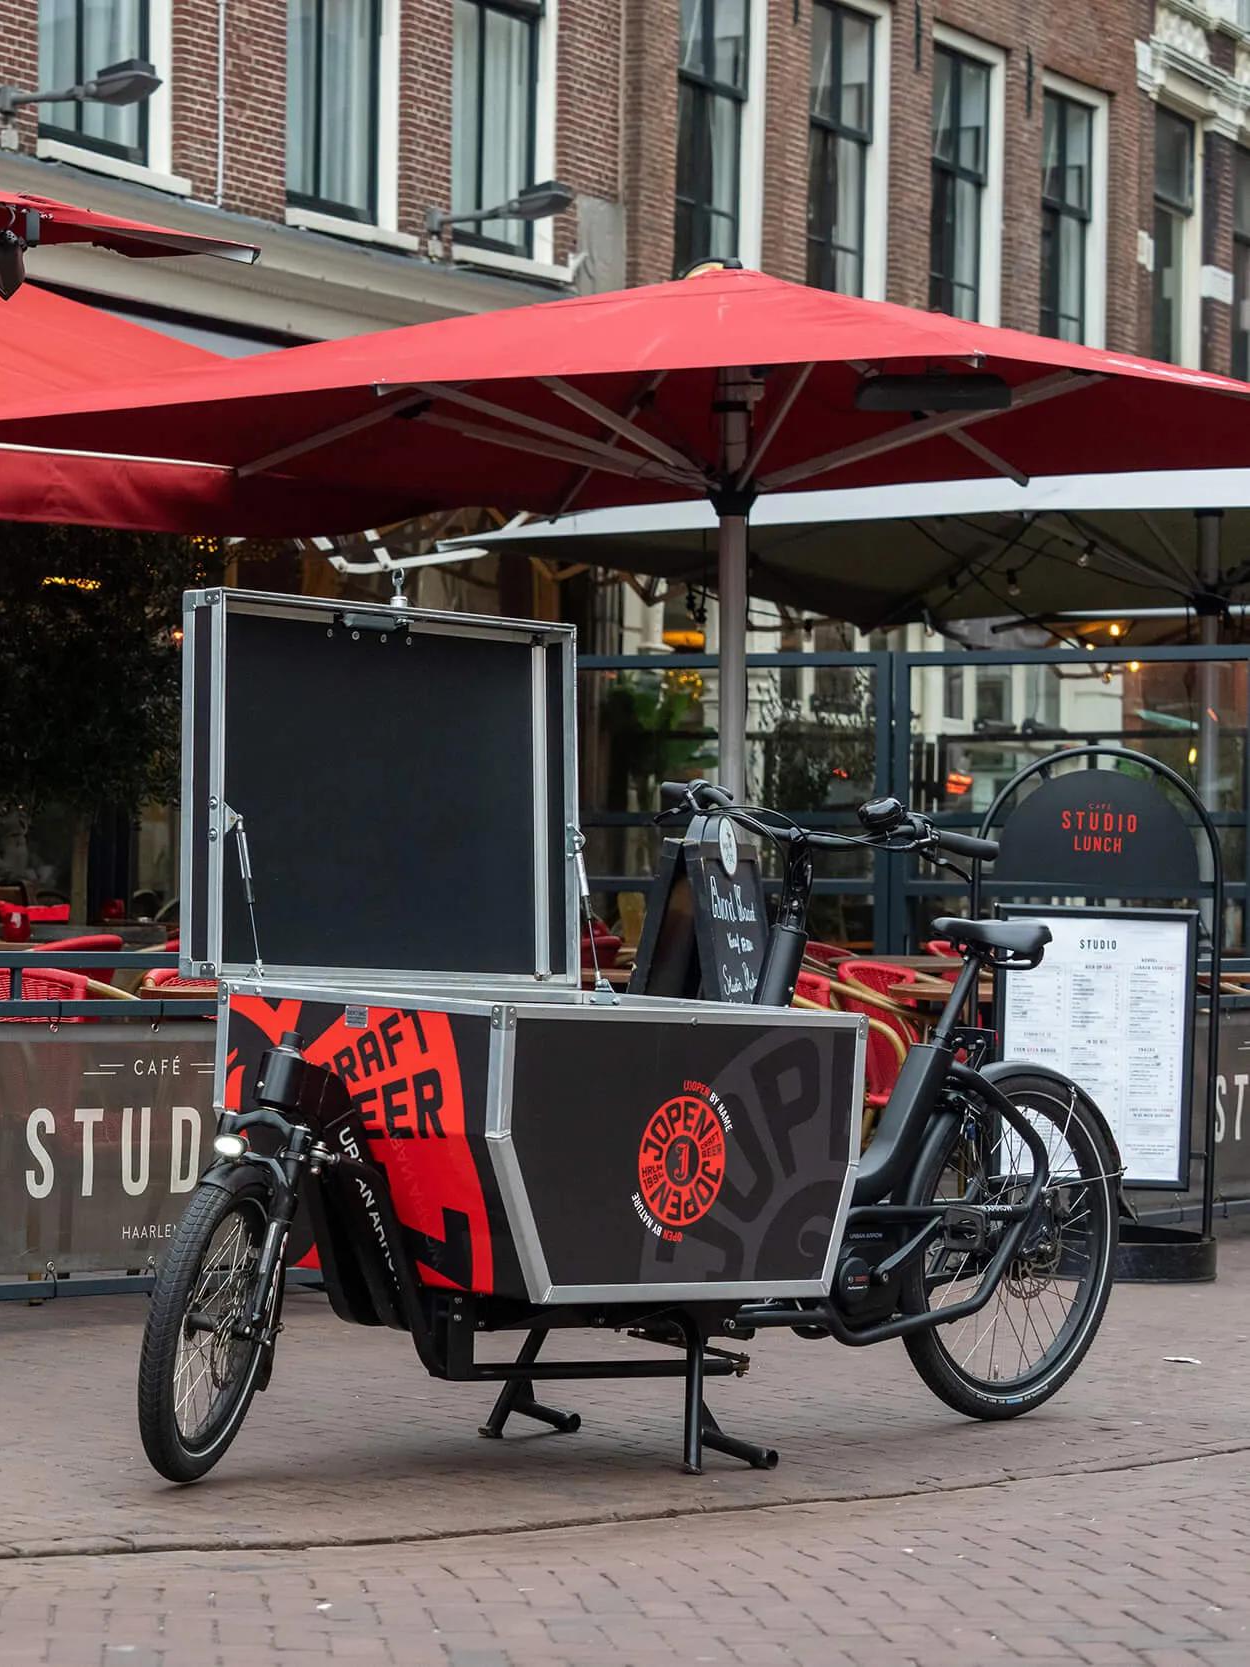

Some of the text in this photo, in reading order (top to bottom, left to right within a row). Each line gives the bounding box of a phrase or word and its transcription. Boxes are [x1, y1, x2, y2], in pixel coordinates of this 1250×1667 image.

[1061, 810, 1138, 833] STUDIO
[1073, 834, 1122, 854] LUNCH
[1079, 939, 1118, 951] STUDIO
[133, 1056, 181, 1076] CAFÉ
[350, 1068, 447, 1140] EER
[709, 1092, 720, 1106] BY
[716, 1103, 733, 1133] NAME
[643, 1101, 716, 1161] JOPEN
[25, 1106, 202, 1199] STUD
[649, 1160, 721, 1221] JOPEN
[631, 1192, 654, 1229] NATURE
[121, 1223, 177, 1240] HAARLE
[651, 1223, 663, 1237] BY
